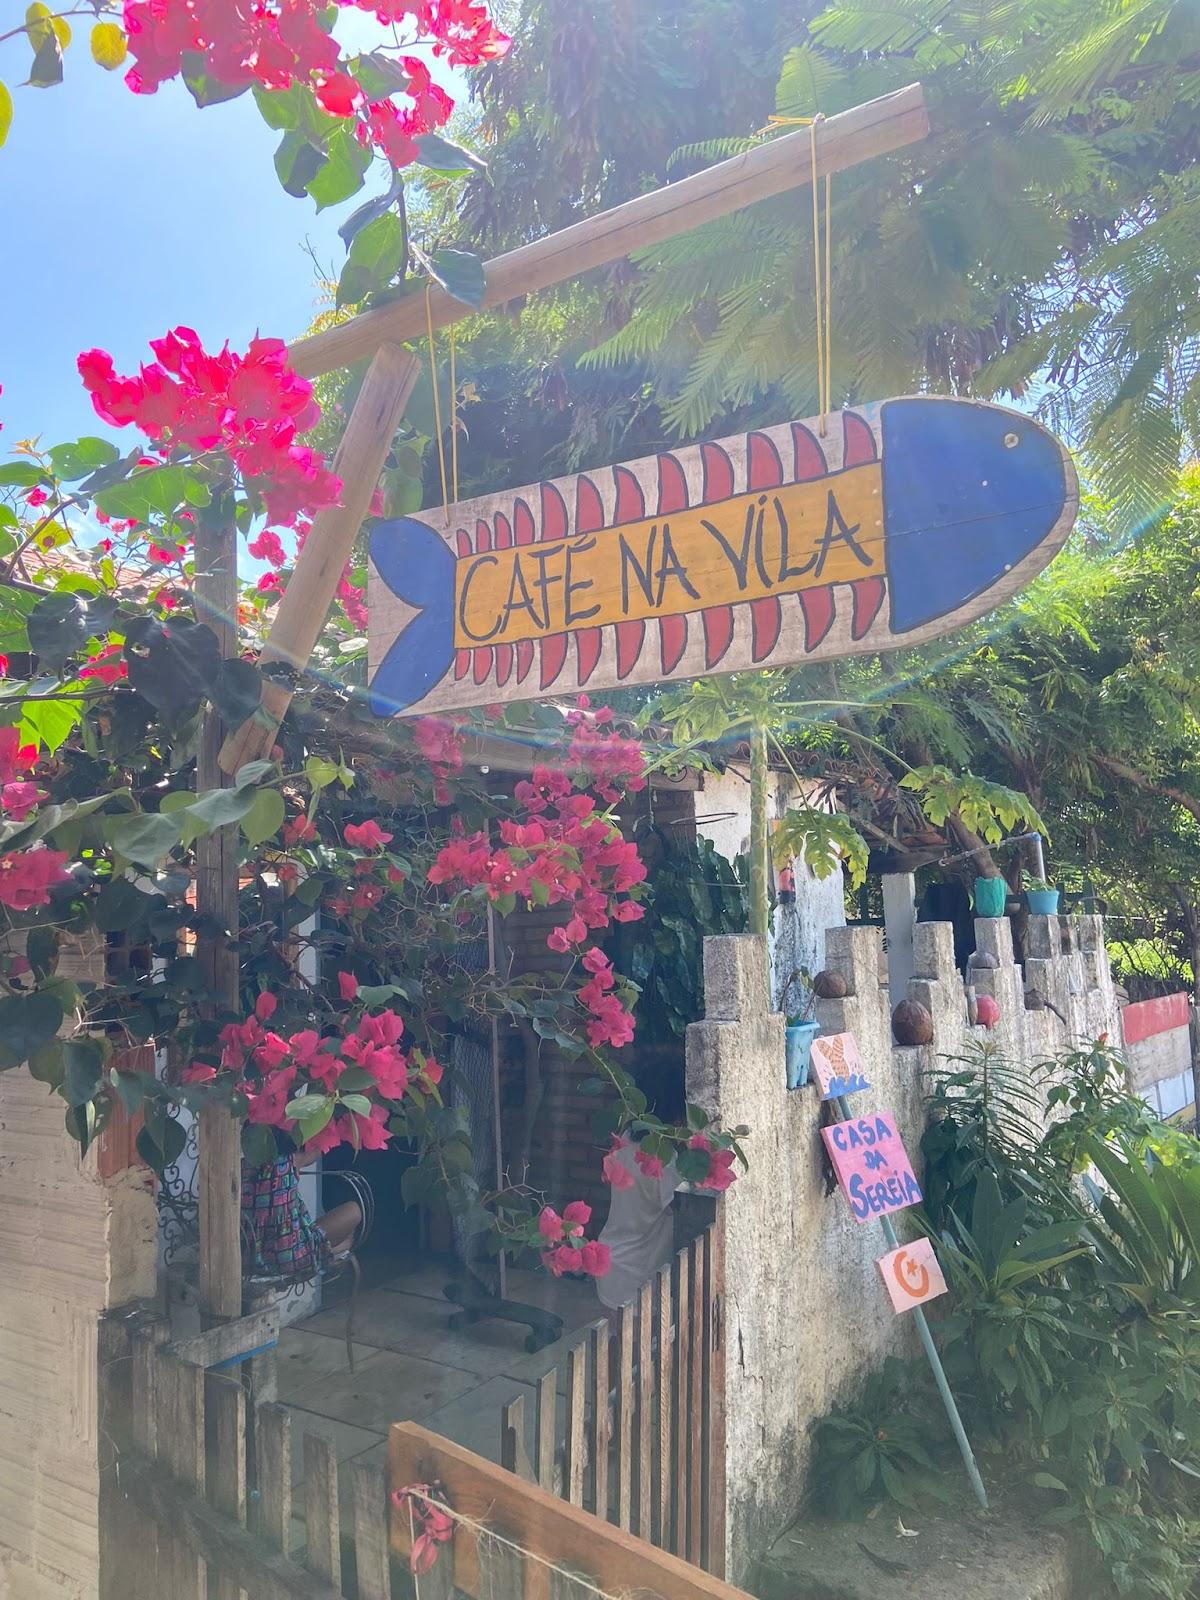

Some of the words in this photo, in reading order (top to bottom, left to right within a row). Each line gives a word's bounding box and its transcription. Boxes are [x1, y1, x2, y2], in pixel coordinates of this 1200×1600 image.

[460, 534, 601, 641] CAFÉ
[619, 523, 701, 615] NA
[833, 1117, 893, 1152] CASA
[863, 1149, 888, 1171] DA
